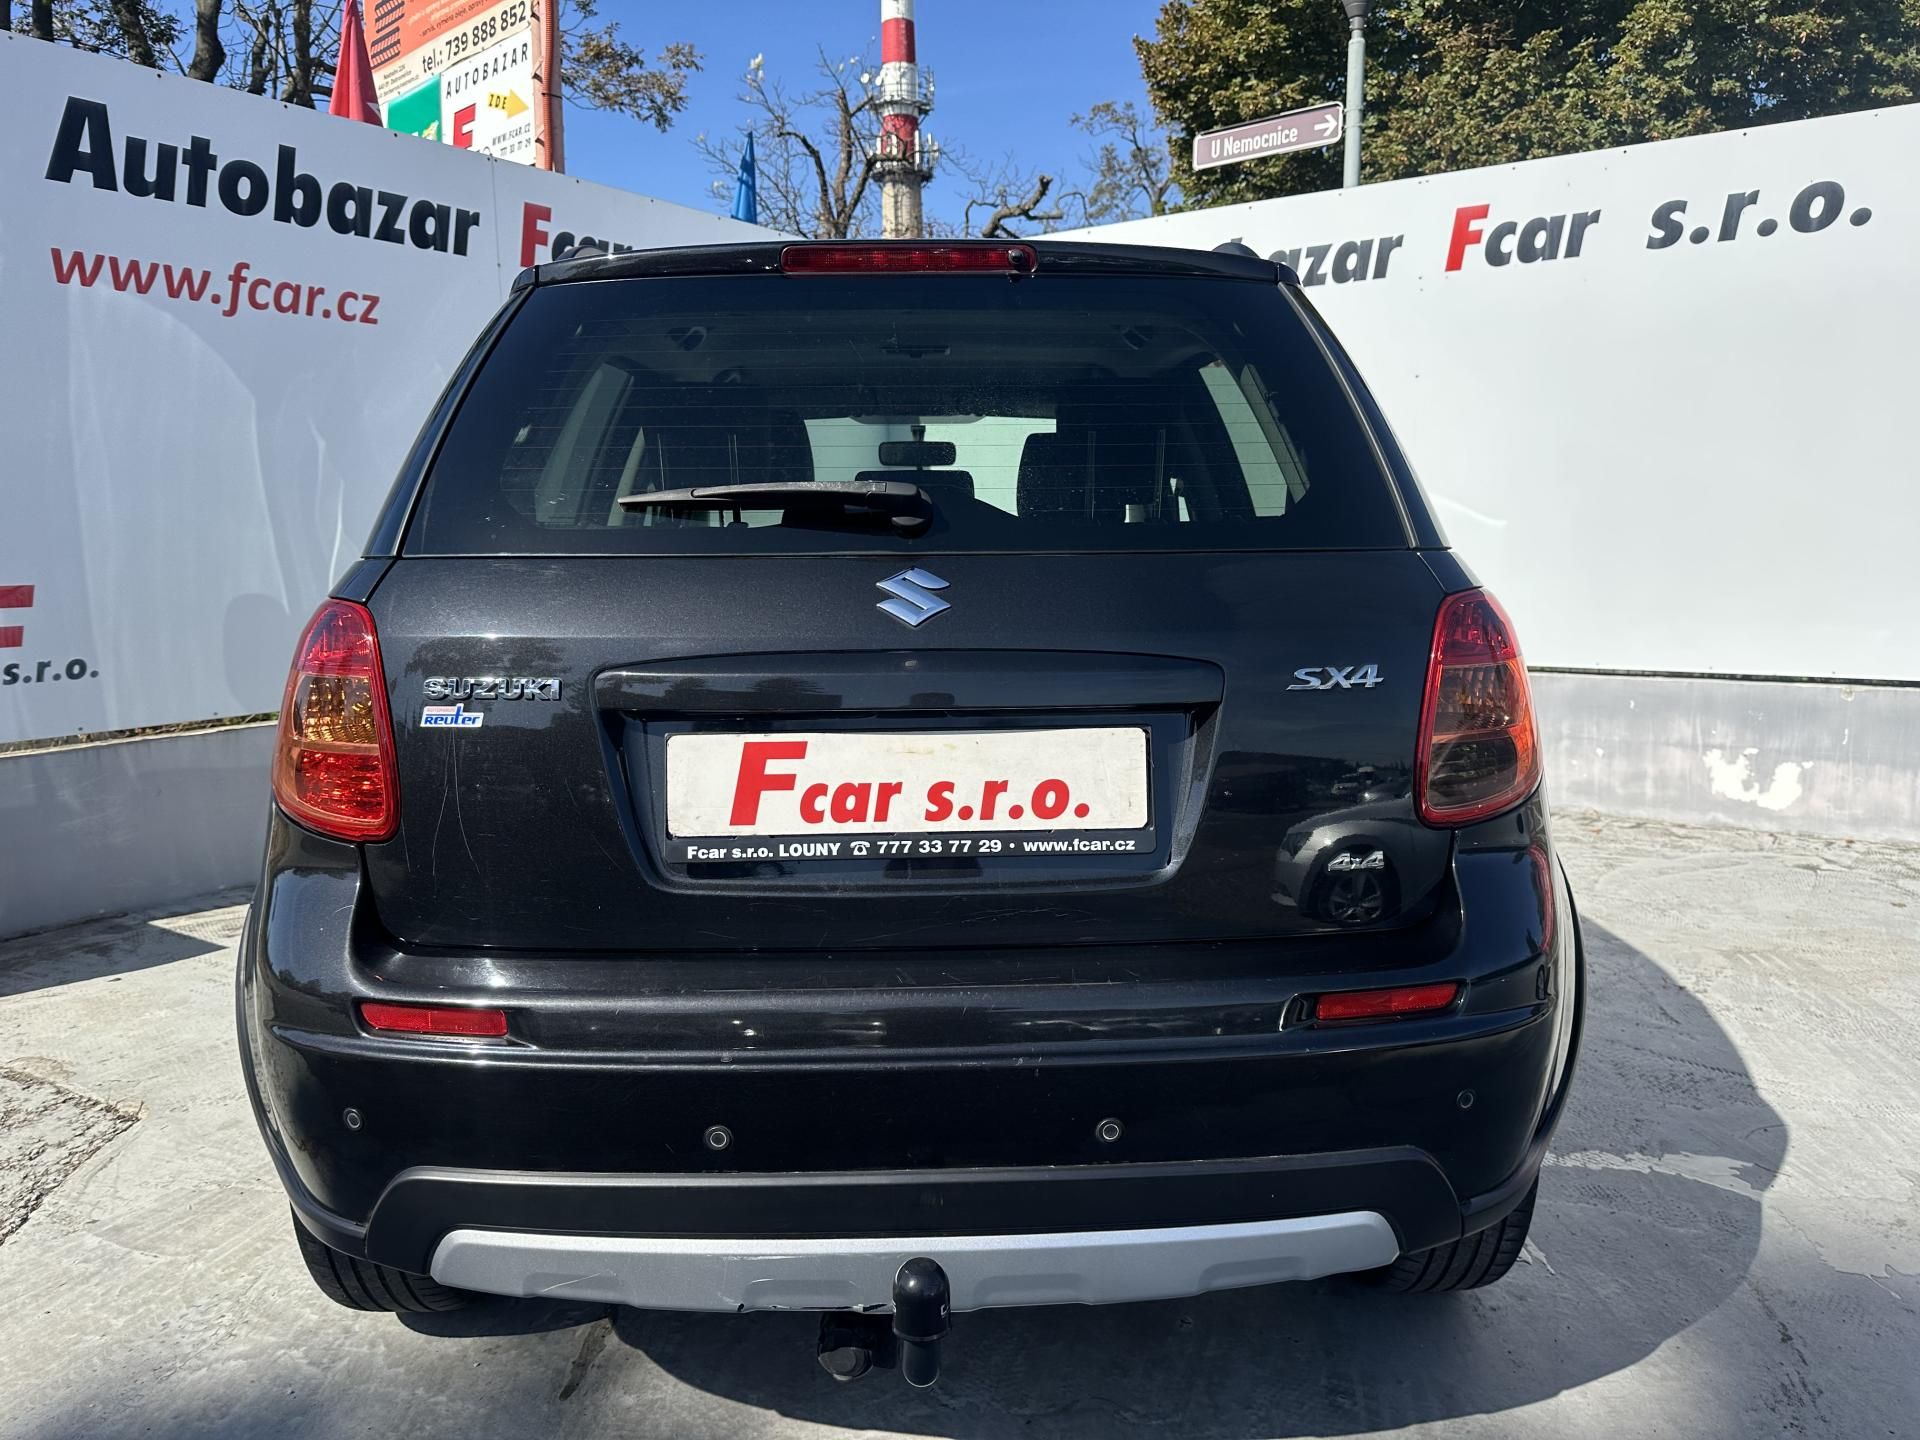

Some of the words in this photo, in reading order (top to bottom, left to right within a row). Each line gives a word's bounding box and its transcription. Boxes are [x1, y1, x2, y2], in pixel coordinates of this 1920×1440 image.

[422, 48, 443, 73] tel.:
[445, 32, 468, 60] 739
[472, 16, 497, 46] 888
[500, 1, 526, 31] 852
[446, 42, 528, 99] AUTOBAZAR
[488, 94, 507, 110] ZDE
[1211, 139, 1221, 158] U
[1223, 126, 1298, 156] Nemocnice
[44, 96, 480, 257] Autobazar
[1444, 203, 1601, 272] Fcar
[1646, 179, 1873, 250] s.r.o.
[50, 246, 381, 325] www.fcar.cz
[2, 658, 99, 686] s.r.o.
[423, 676, 561, 700] SUZUKI
[1286, 664, 1384, 690] SX4
[729, 741, 903, 826] Fcar
[925, 778, 1090, 822] s.r.o.
[687, 845, 727, 859] Fcar
[732, 845, 774, 858] s.r.o.
[778, 843, 841, 858] LOUNY
[877, 841, 912, 855] 777
[918, 841, 943, 854] 33
[949, 840, 974, 854] 77
[979, 840, 1002, 853] 29
[1023, 839, 1135, 853] www.fcar.cz
[1328, 850, 1385, 871] 4x4
